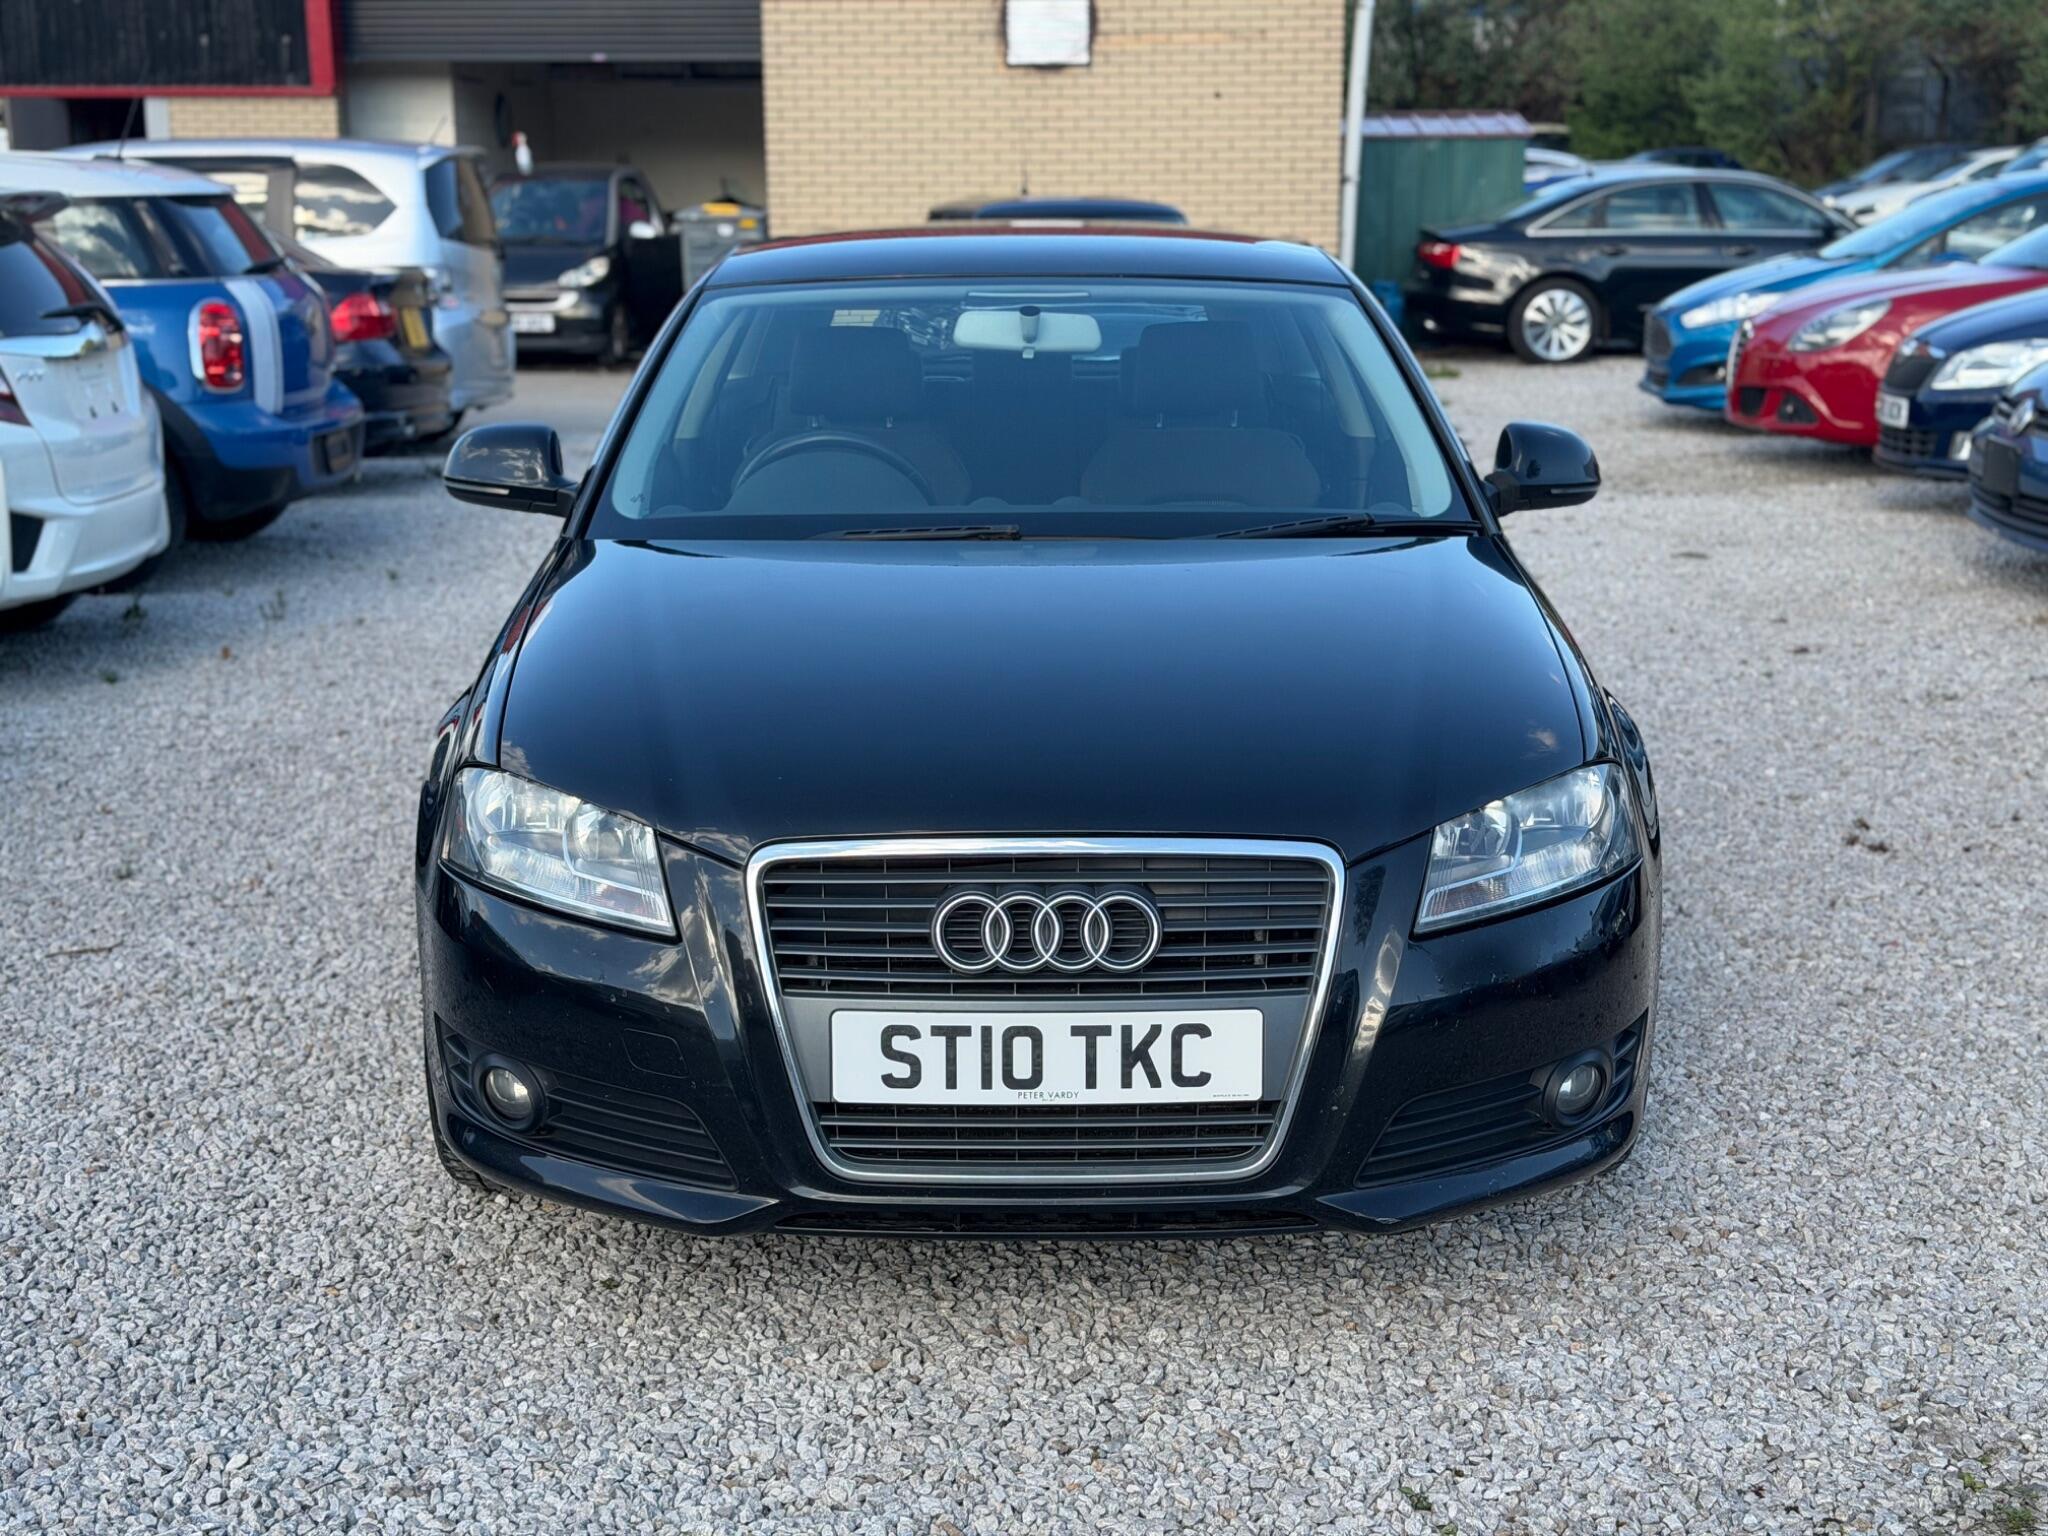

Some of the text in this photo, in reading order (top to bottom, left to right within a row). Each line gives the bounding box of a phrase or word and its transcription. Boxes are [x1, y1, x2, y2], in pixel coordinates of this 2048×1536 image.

[880, 1023, 1212, 1090] ST10 TKC
[1017, 1091, 1079, 1099] PETER VARDY
